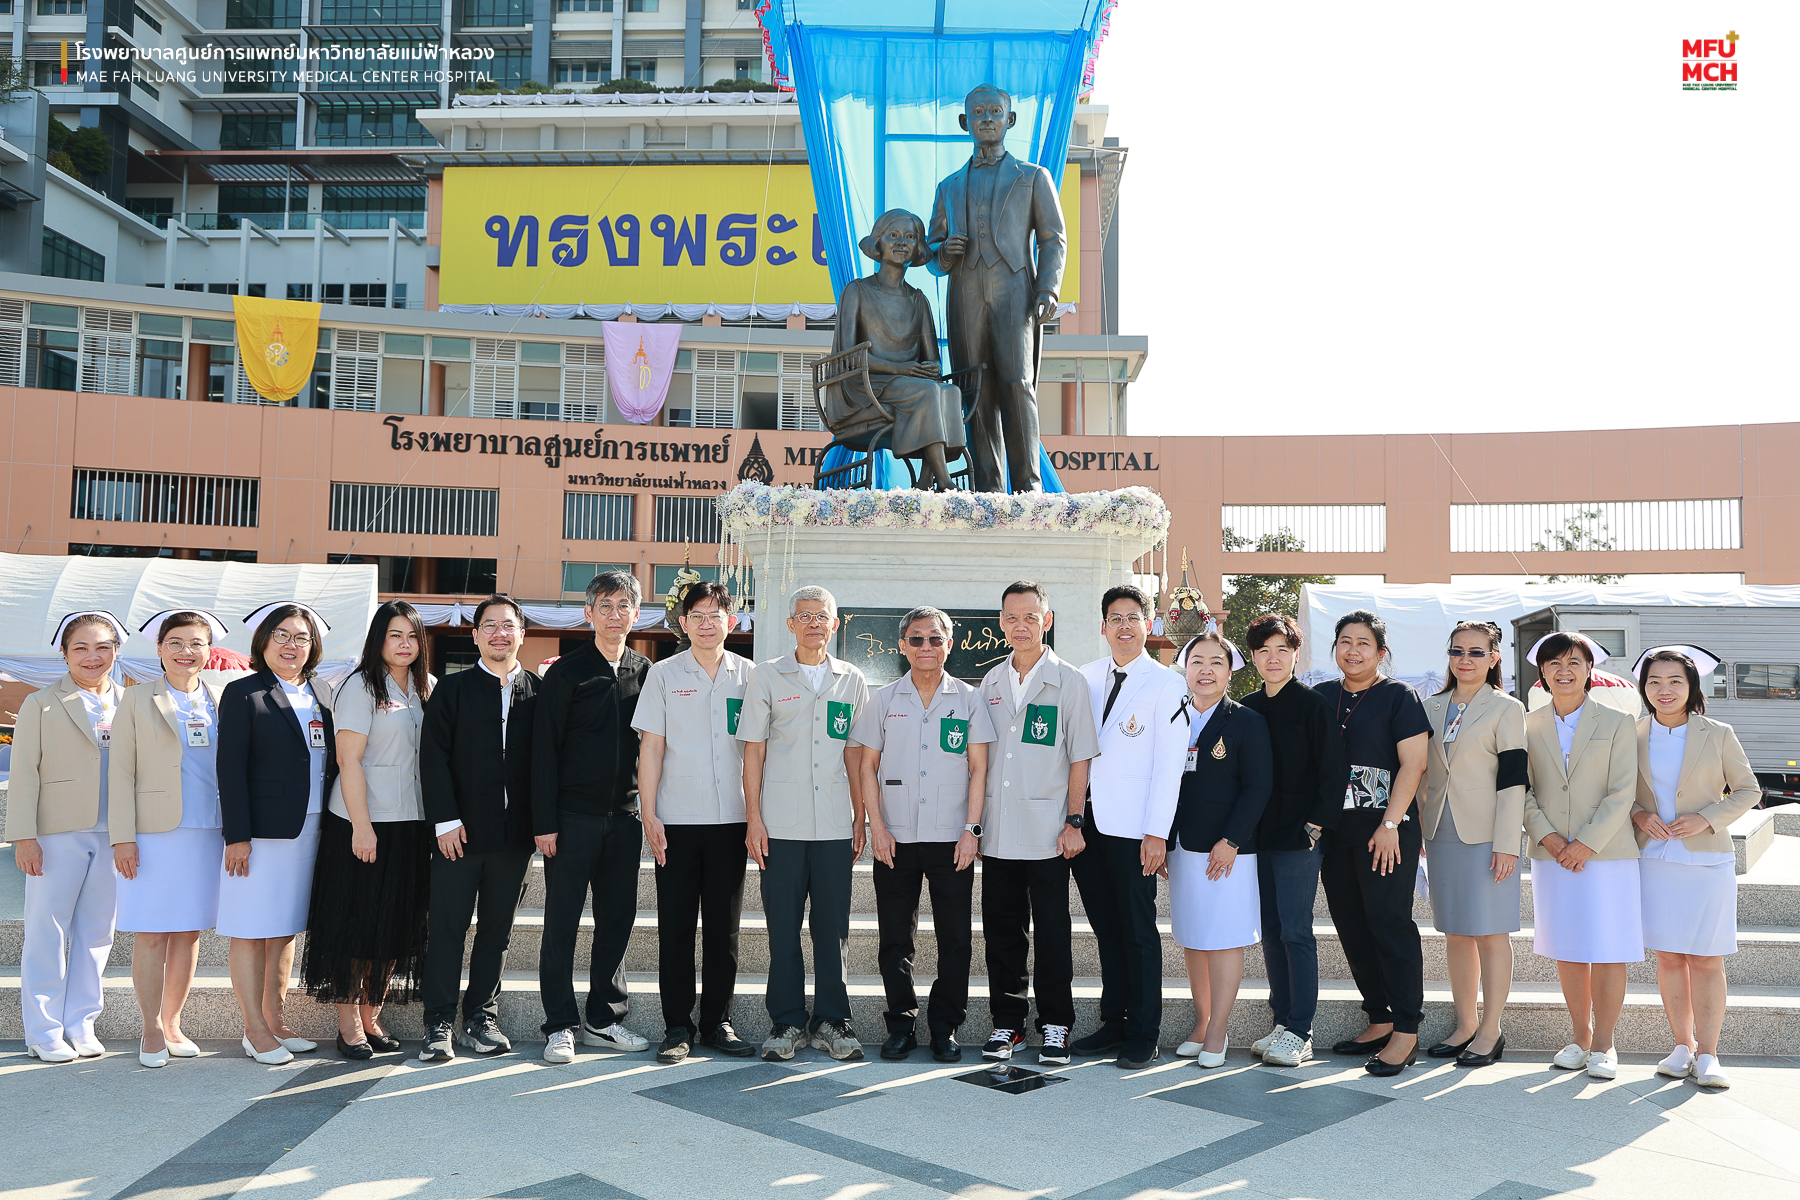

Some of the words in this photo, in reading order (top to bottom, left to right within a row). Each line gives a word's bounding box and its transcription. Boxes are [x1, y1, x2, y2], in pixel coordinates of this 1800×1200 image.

[382, 415, 732, 469] โรงพยาบาลศูนย์การแพทย์
[1047, 450, 1160, 471] OSPITAL
[567, 471, 727, 490] มหาวิทยาลัยแม่ฟ้าหลวง
